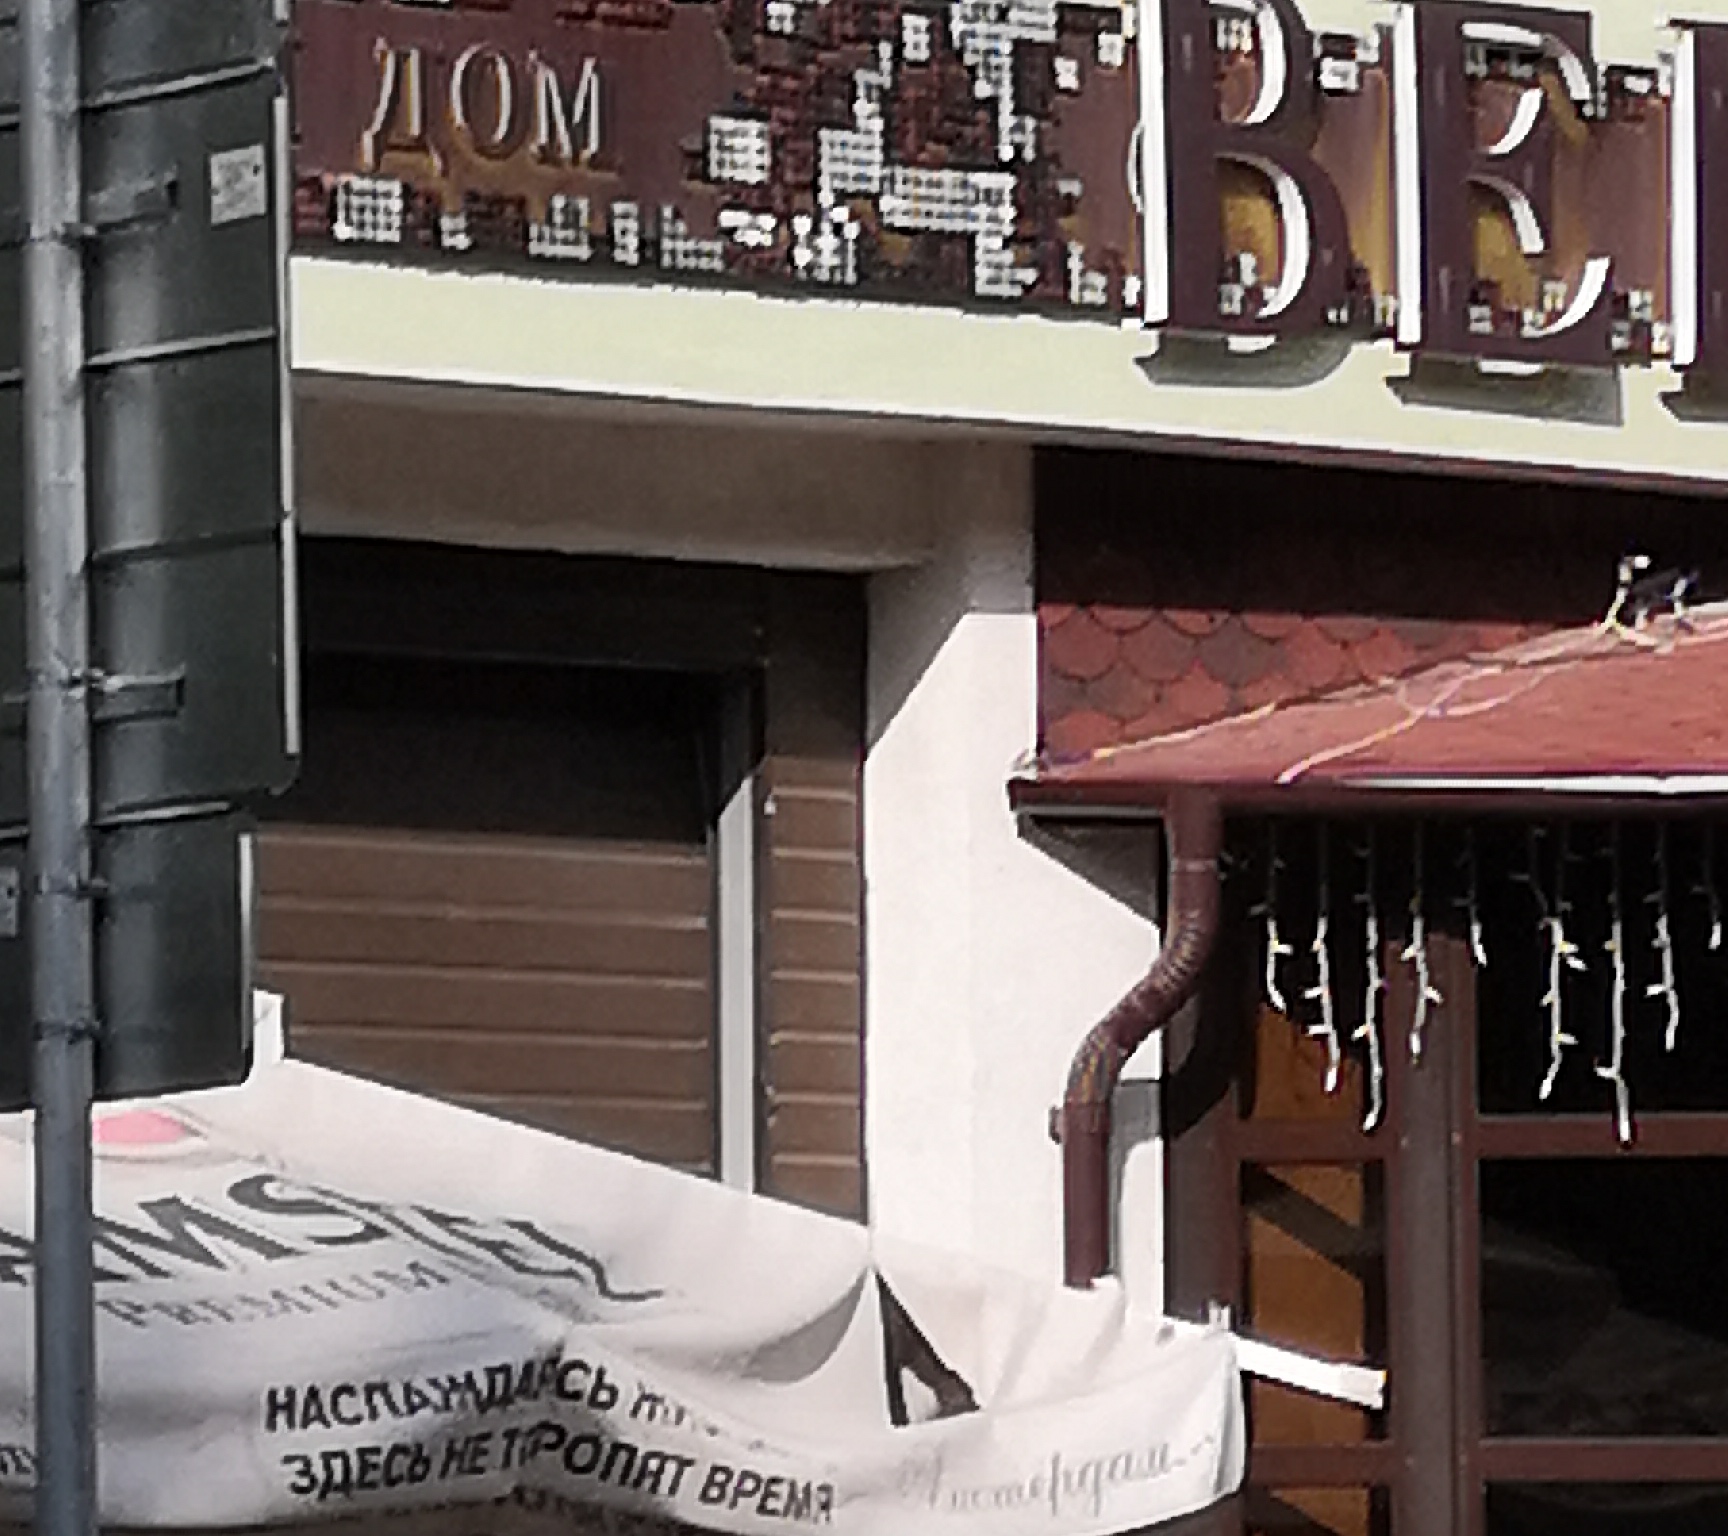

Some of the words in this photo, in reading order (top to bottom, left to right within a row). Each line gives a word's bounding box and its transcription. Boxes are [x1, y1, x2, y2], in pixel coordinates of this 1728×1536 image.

[360, 36, 604, 176] ДОМ
[280, 1441, 433, 1503] ЗДЕСЬ
[437, 1430, 494, 1480] НЕ
[698, 1463, 835, 1525] ВРЕМЯ
